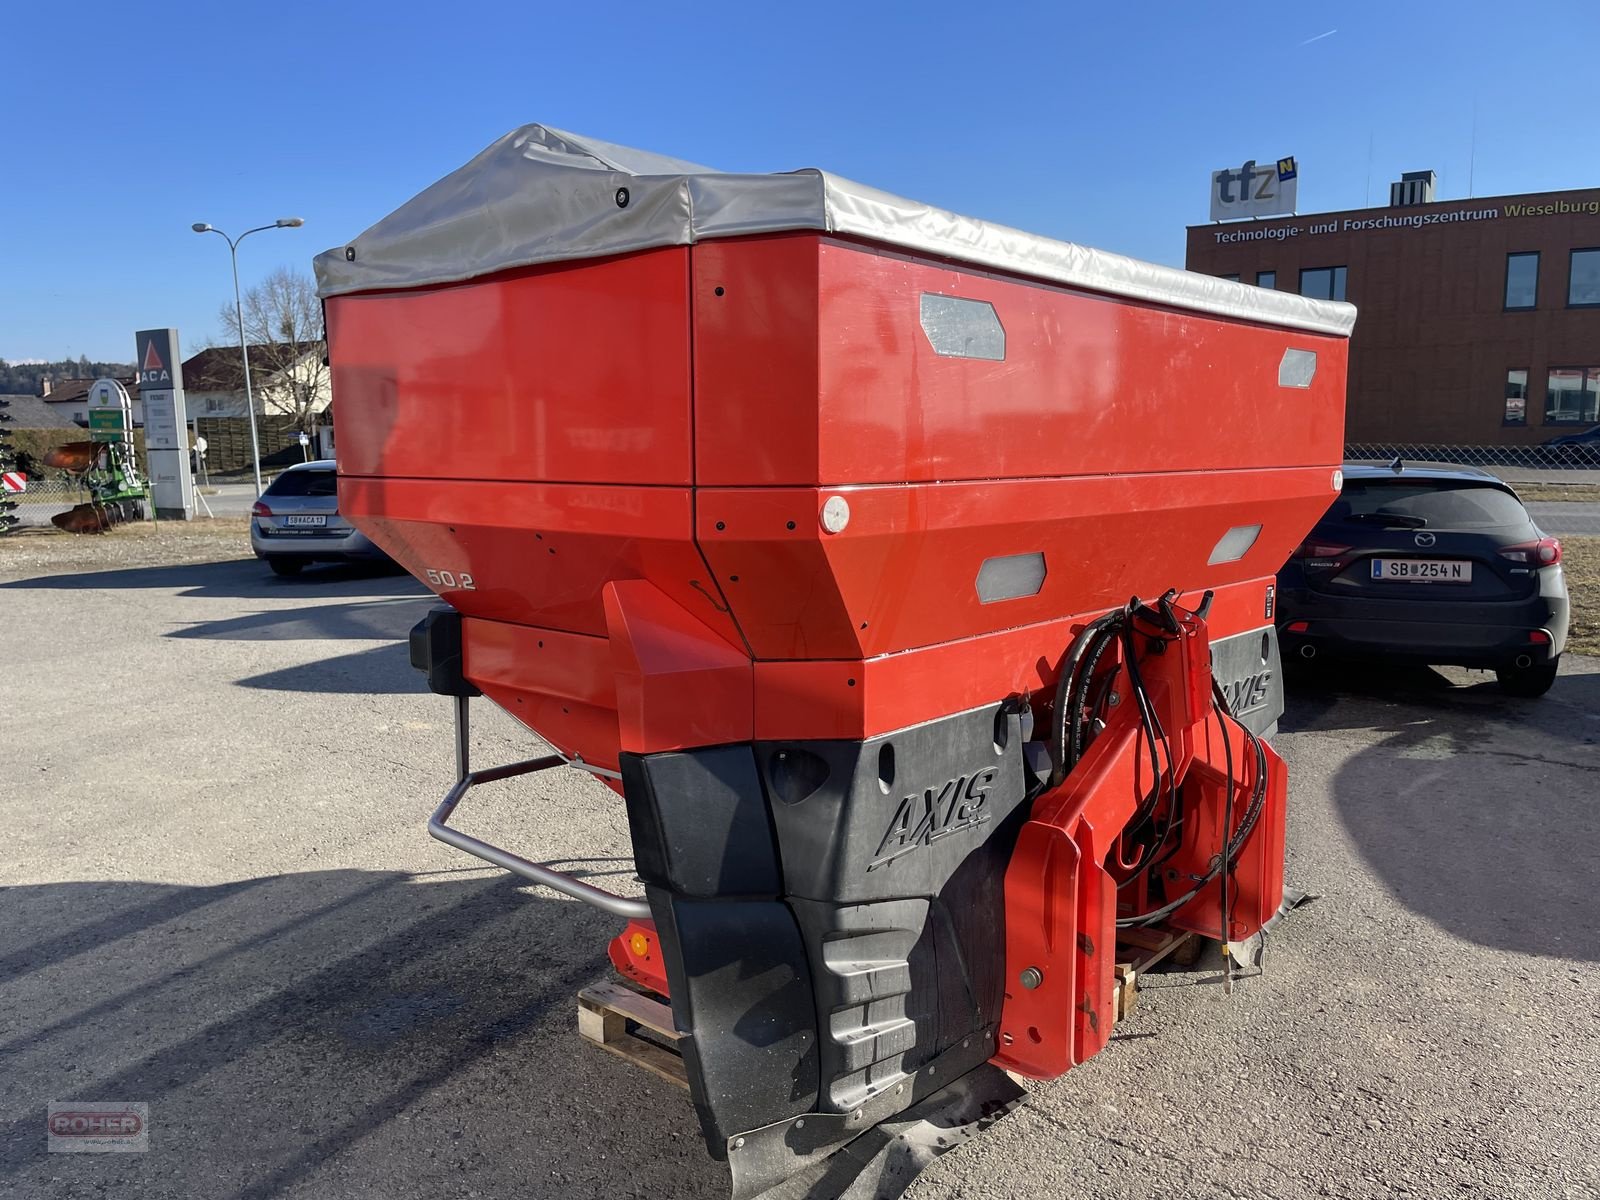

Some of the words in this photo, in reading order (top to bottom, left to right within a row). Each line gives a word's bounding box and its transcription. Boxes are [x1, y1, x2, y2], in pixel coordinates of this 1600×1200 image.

[1216, 160, 1276, 203] tfz
[1214, 225, 1304, 244] Technologie-
[1309, 220, 1338, 235] und
[1343, 208, 1498, 231] Forschungszentrum
[1504, 201, 1600, 217] Wieselburg
[141, 370, 169, 382] ACA
[426, 569, 476, 590] 50.2
[1390, 562, 1408, 576] SB
[1420, 563, 1448, 577] 254
[1452, 564, 1461, 577] N
[875, 766, 999, 857] AXIS
